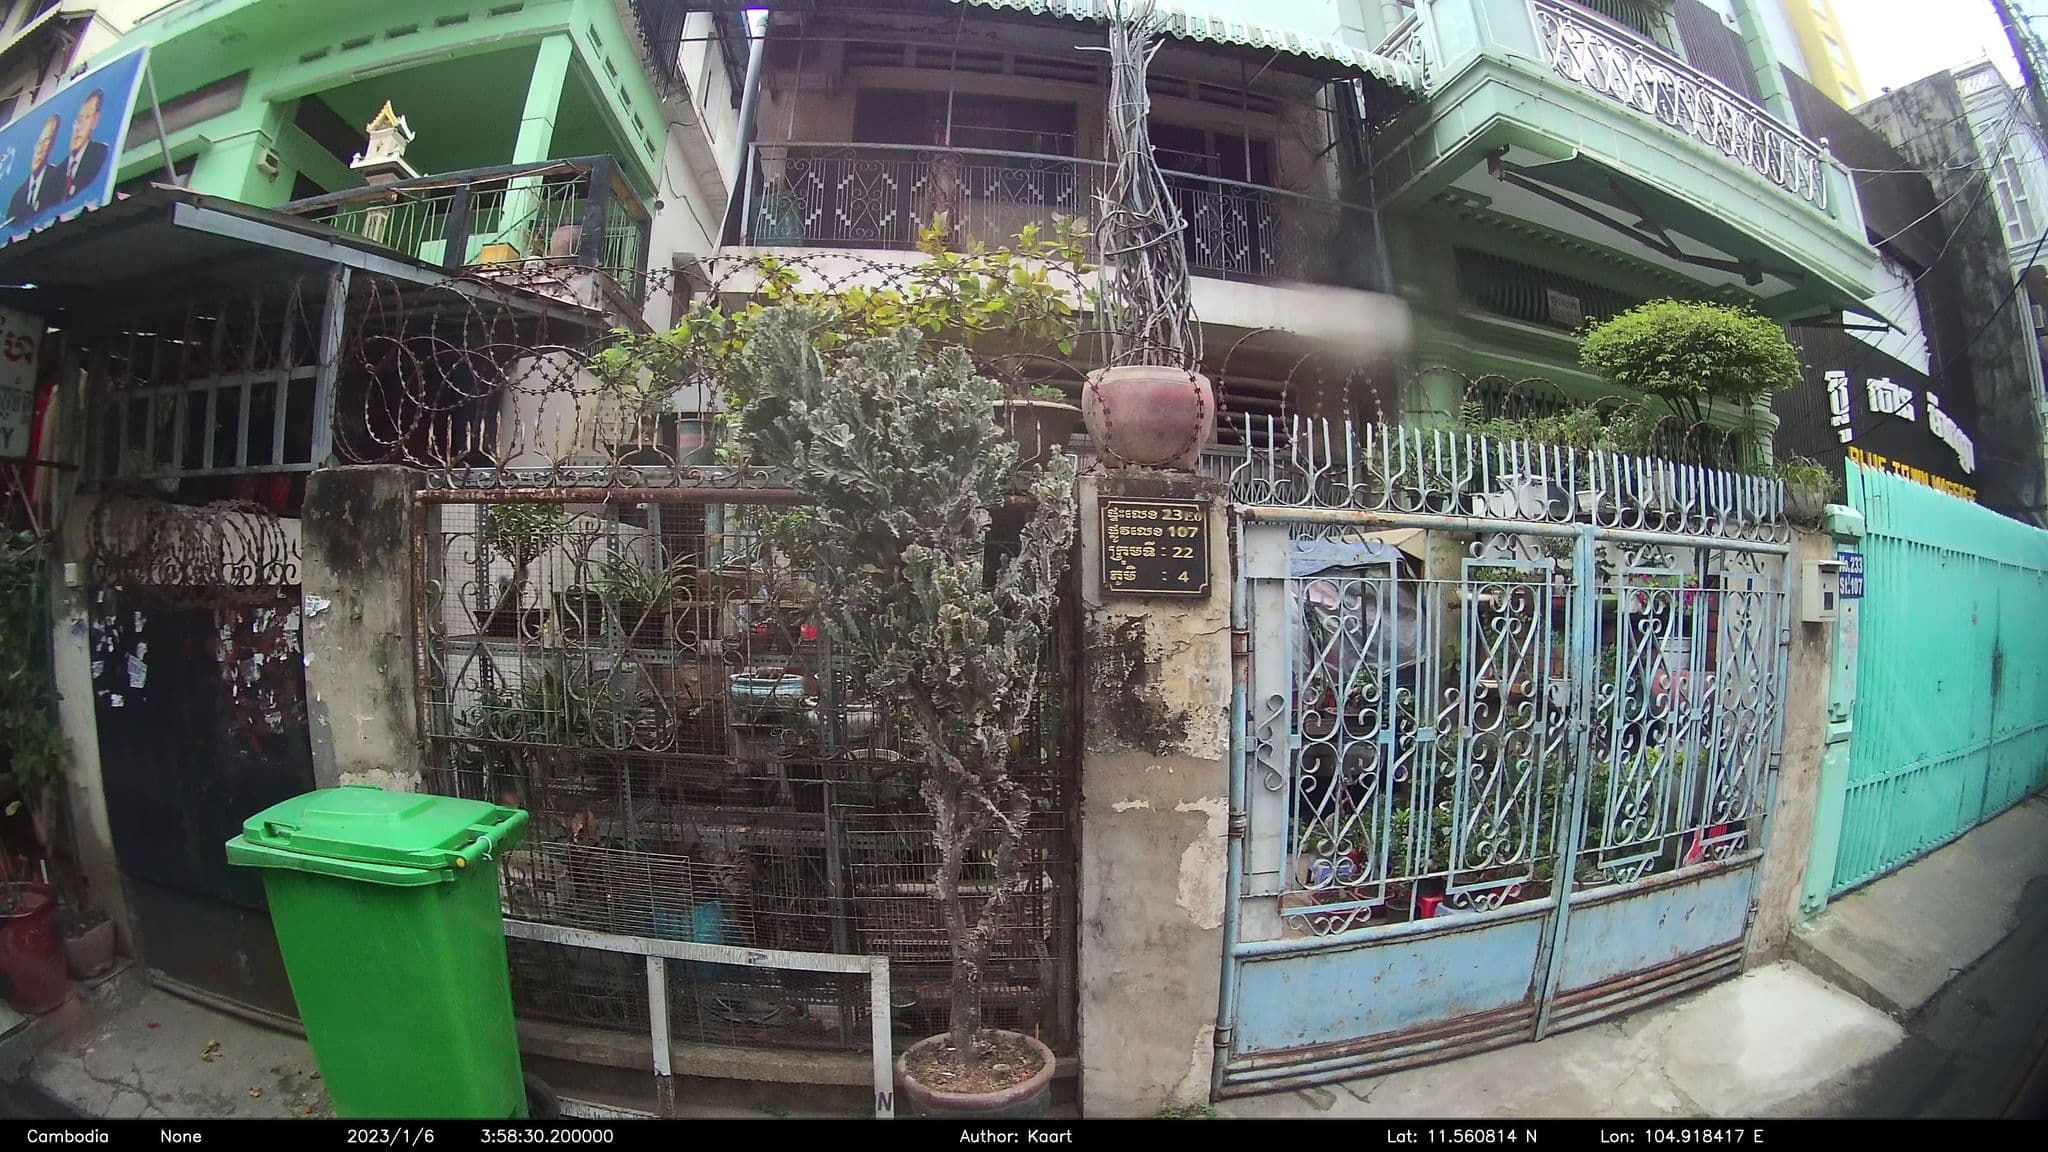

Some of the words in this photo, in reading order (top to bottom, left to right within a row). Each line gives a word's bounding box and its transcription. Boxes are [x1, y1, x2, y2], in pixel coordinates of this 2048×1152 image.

[1892, 460, 1930, 487] TOWN
[1167, 526, 1198, 538] 107
[1172, 546, 1194, 559] 22
[1177, 570, 1190, 583] 4
